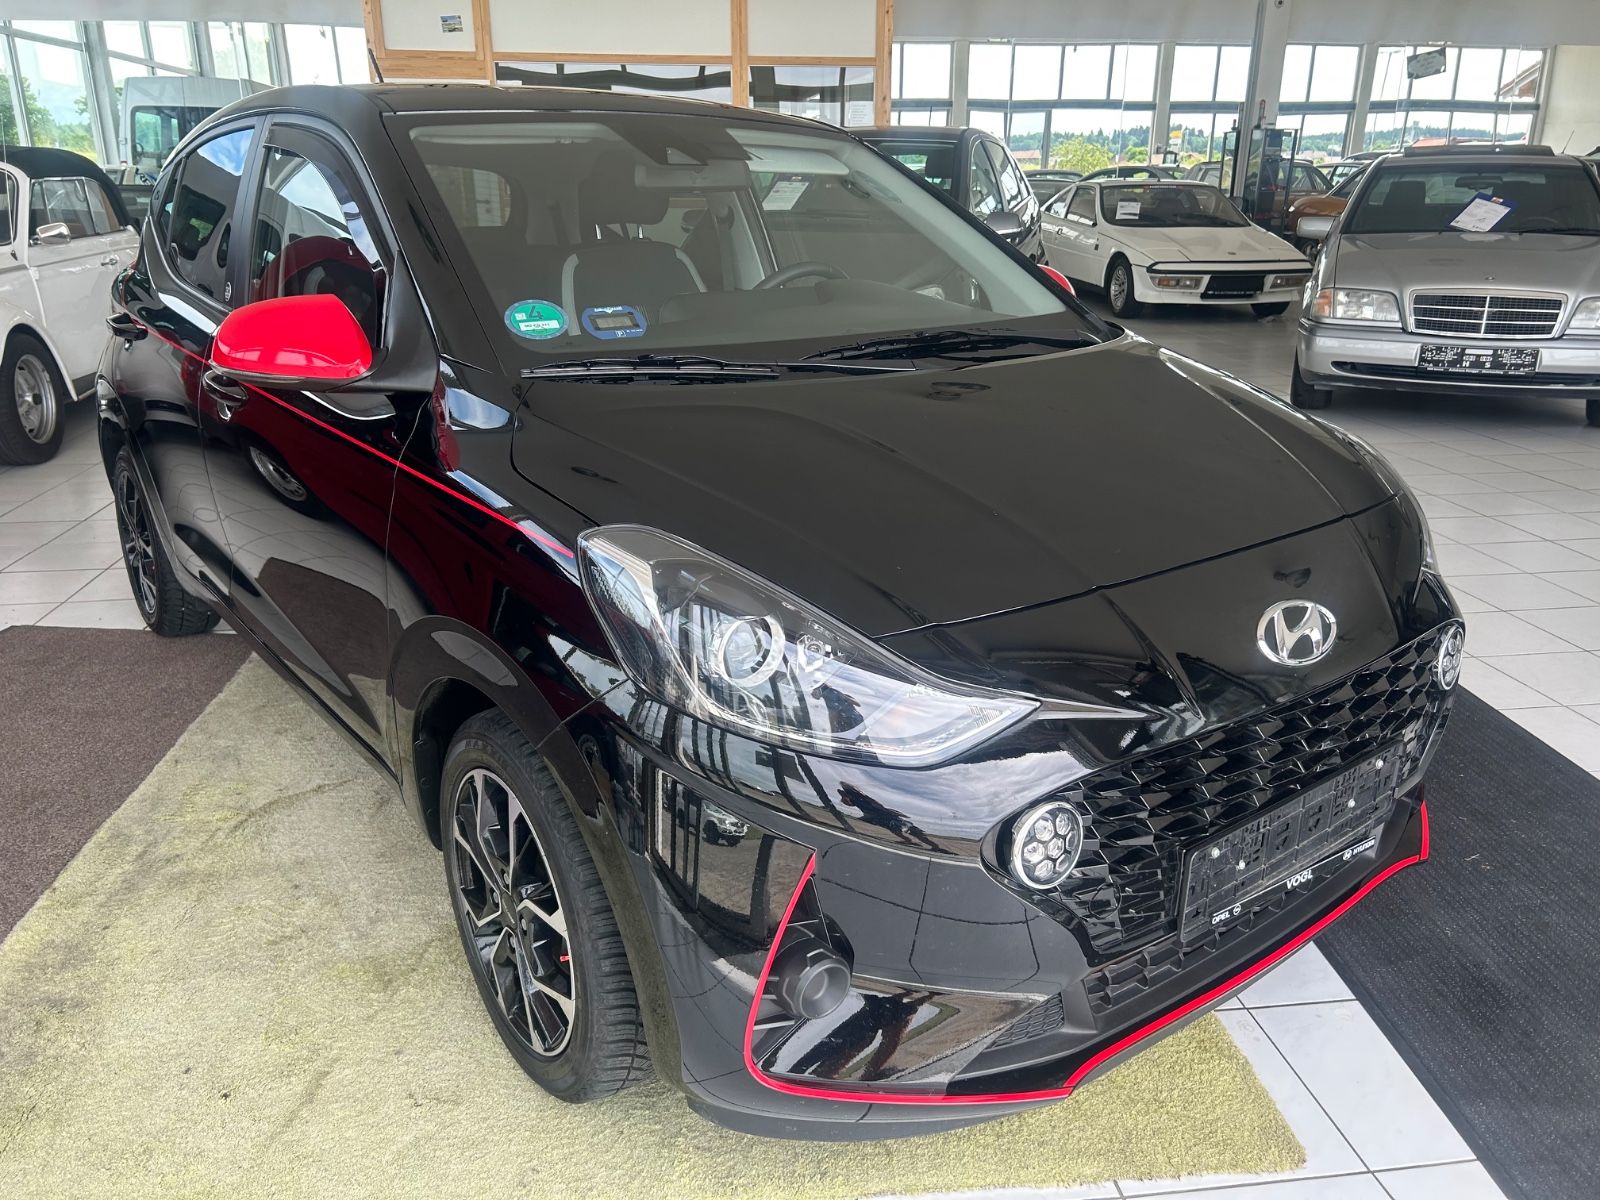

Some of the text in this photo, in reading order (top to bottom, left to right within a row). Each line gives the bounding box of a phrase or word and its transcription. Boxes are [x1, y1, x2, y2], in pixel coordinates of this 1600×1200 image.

[528, 305, 544, 320] 4
[1212, 911, 1230, 924] OPEL
[1286, 870, 1313, 889] VOGL
